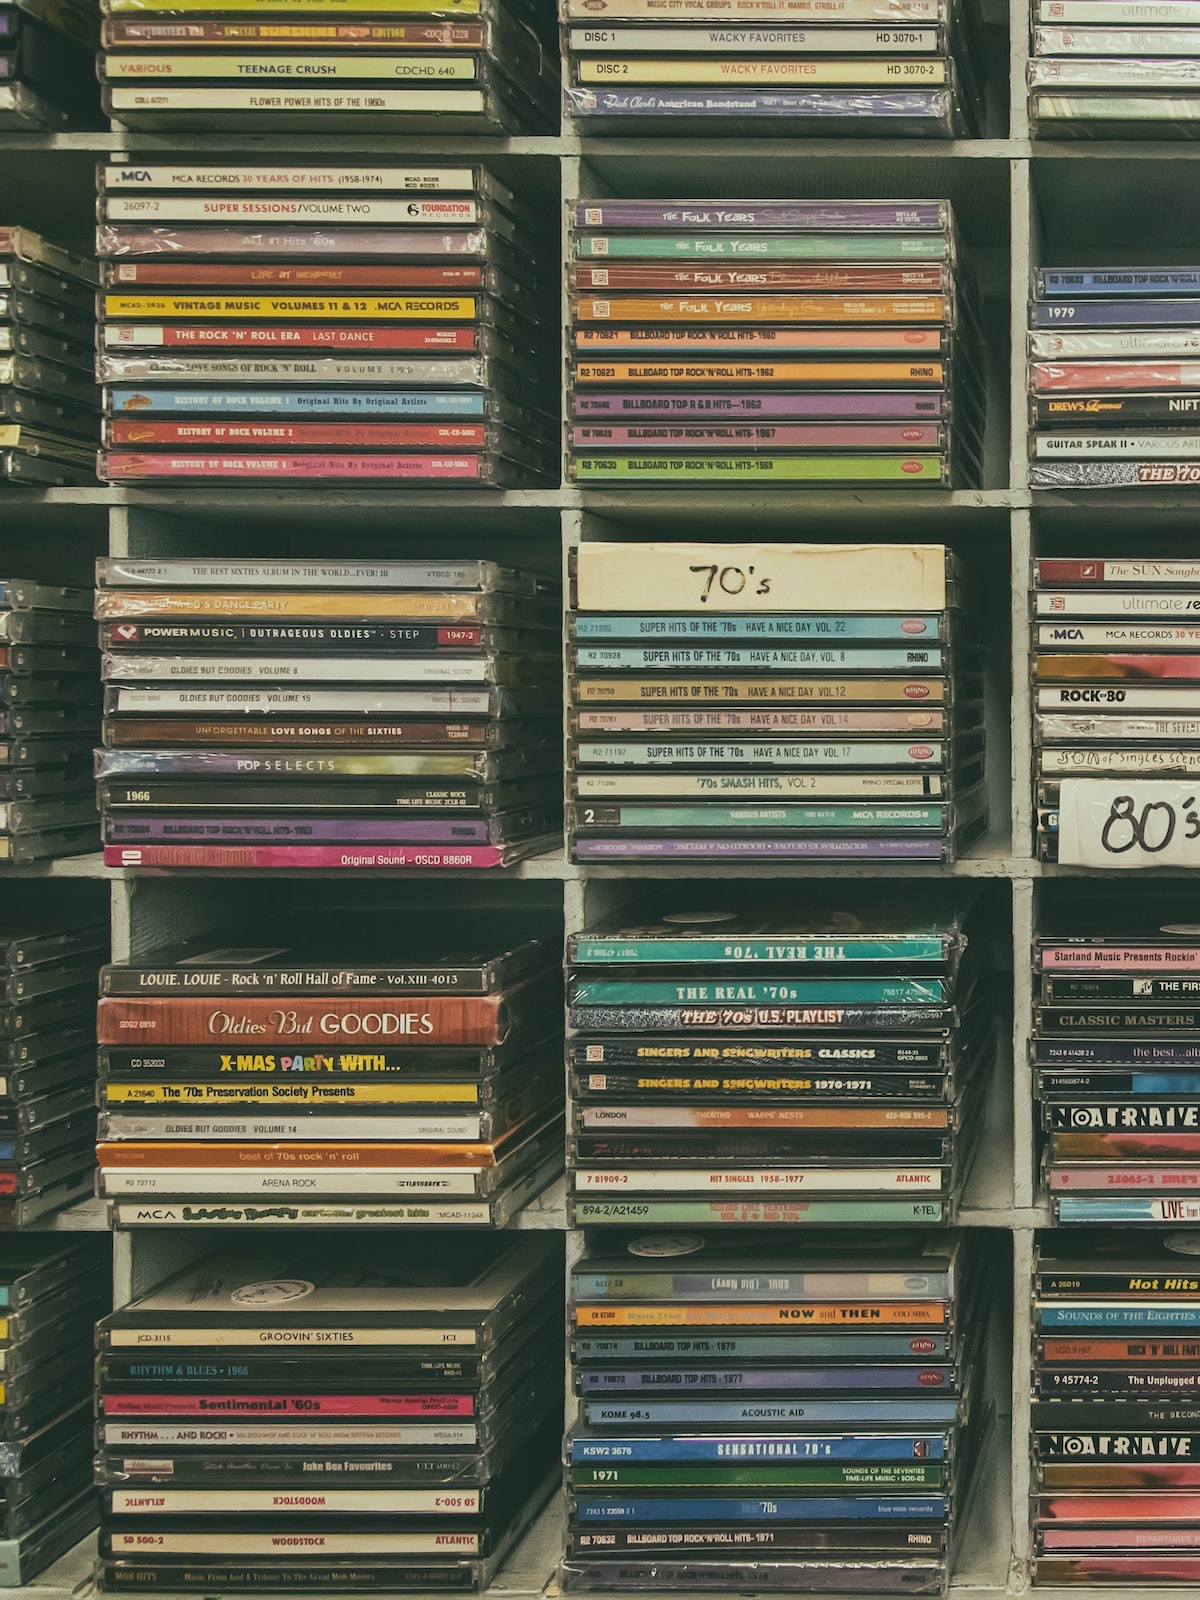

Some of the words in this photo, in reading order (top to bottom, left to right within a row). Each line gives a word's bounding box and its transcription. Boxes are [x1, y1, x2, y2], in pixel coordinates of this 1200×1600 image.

[585, 32, 607, 41] DISC
[611, 33, 615, 41] 1
[709, 31, 746, 42] WACKY
[750, 31, 805, 42] FAVORITES
[876, 33, 890, 42] HD
[893, 34, 922, 42] 3070-1
[120, 64, 172, 73] VARIOUS
[238, 65, 291, 73] TEENAGE
[296, 66, 336, 74] CRUSH
[396, 67, 435, 76] CDCHD
[439, 67, 455, 75] 640
[124, 200, 159, 211] 26097-2
[204, 204, 239, 212] SUPER
[243, 203, 342, 214] SESSIONS/VOLUME
[346, 201, 371, 213] TWO
[1049, 308, 1075, 318] 1979
[1087, 440, 1117, 448] SPEAK
[1121, 440, 1127, 448] II
[1138, 438, 1179, 448] VARIOUS
[1110, 565, 1129, 576] The
[1132, 564, 1161, 576] SUN
[689, 565, 770, 603] 70's
[1122, 597, 1182, 610] ultimate
[644, 649, 669, 661] SUPER
[673, 649, 690, 661] HITS
[694, 649, 703, 661] OF
[706, 649, 720, 661] THE
[751, 650, 770, 661] HAVE
[773, 650, 778, 661] A
[781, 650, 797, 661] NICE
[840, 650, 845, 661] 8
[907, 653, 928, 662] RHINO
[126, 790, 150, 801] 1966
[341, 855, 375, 867] Original
[378, 855, 406, 864] Sound
[414, 855, 441, 864] OSCD
[443, 855, 472, 864] 8860R
[1159, 982, 1179, 990] THE
[676, 987, 708, 999] THE
[715, 987, 756, 999] REAL
[209, 1011, 266, 1034] Oldies
[271, 1011, 313, 1034] But
[320, 1013, 433, 1035] GOODIES
[162, 1087, 180, 1097] The
[207, 1087, 268, 1097] Preservation
[272, 1086, 308, 1098] Society
[312, 1086, 355, 1096] Presents
[262, 1179, 290, 1187] ARENA
[292, 1179, 316, 1187] ROCK
[895, 1175, 931, 1183] ATLANTIC
[582, 1205, 649, 1215] 894-2/A21459
[1129, 1279, 1159, 1290] Hot
[1165, 1279, 1198, 1289] Hits
[1127, 1376, 1145, 1384] The
[1147, 1376, 1194, 1386] Unplugged
[584, 1447, 609, 1455] KSW2
[718, 1444, 797, 1455] SENSATIONAL
[805, 1444, 830, 1454] 70's
[593, 1471, 617, 1480] 1971
[137, 1534, 163, 1544] 500-2
[435, 1534, 475, 1544] ATLANTIC
